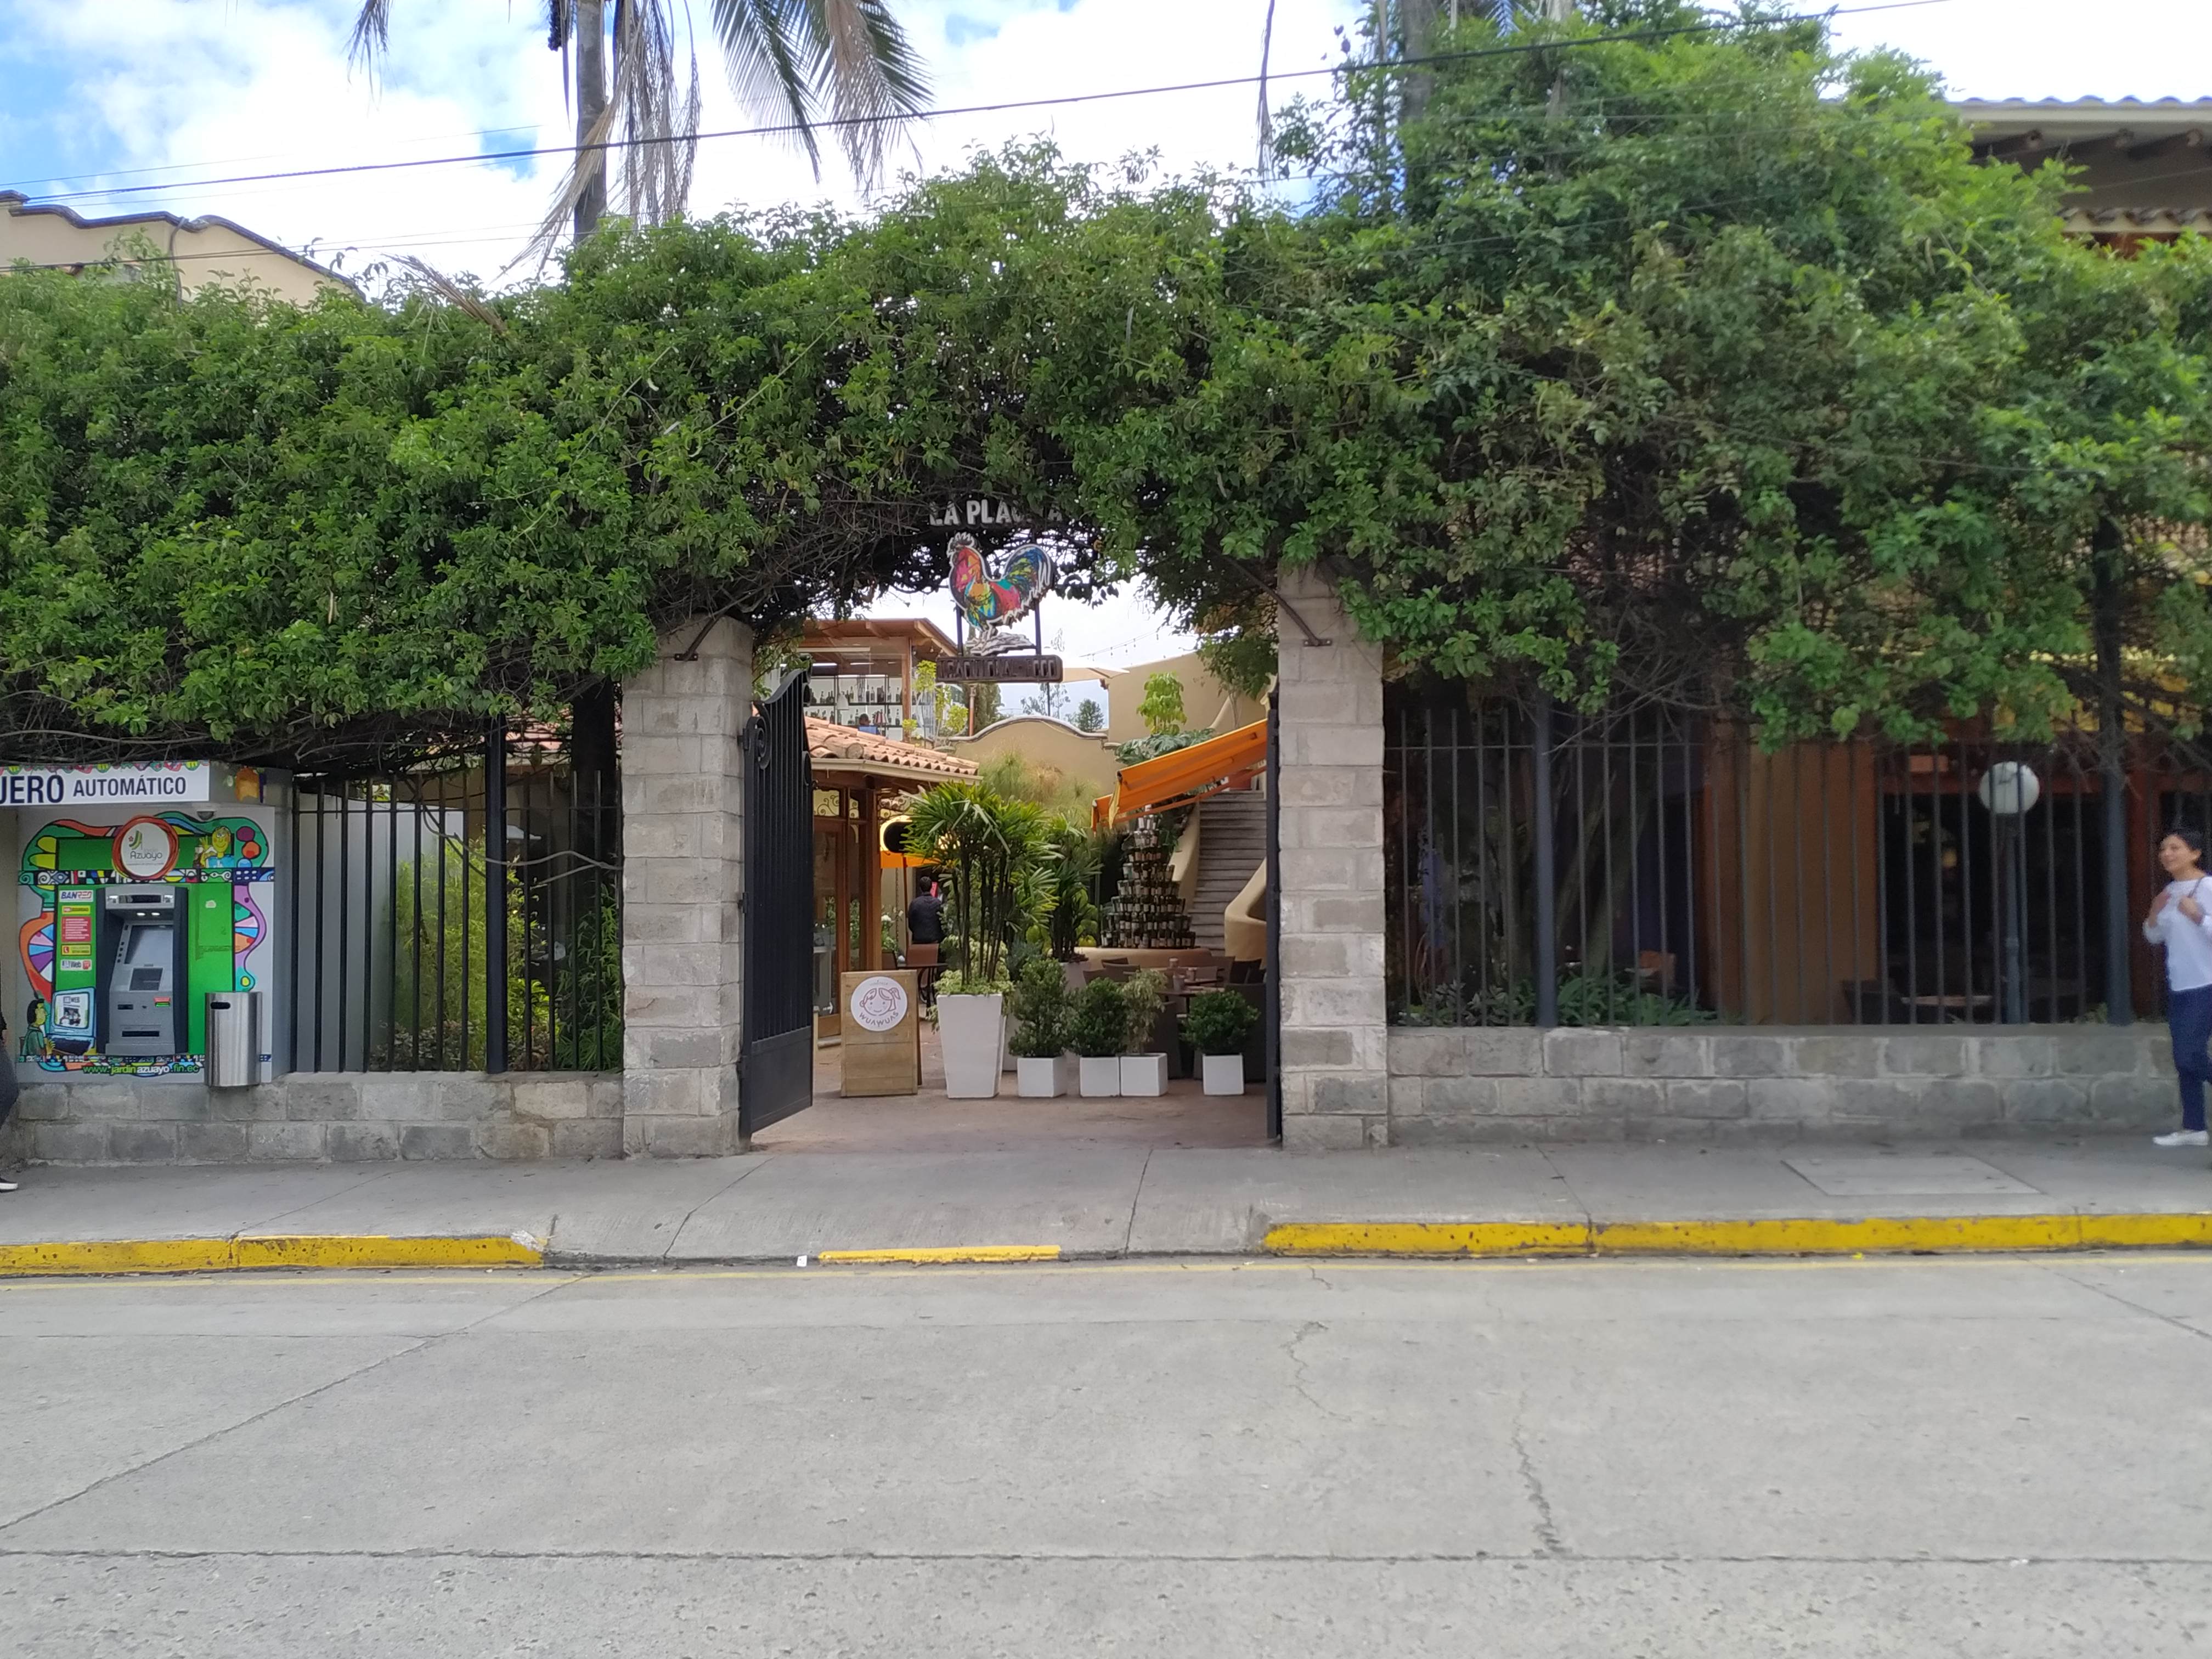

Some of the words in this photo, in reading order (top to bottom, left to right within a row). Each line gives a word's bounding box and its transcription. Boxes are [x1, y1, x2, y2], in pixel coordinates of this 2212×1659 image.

[929, 500, 960, 526] LA
[73, 775, 186, 797] AUTOMÁTICO
[129, 850, 163, 861] Azuayo
